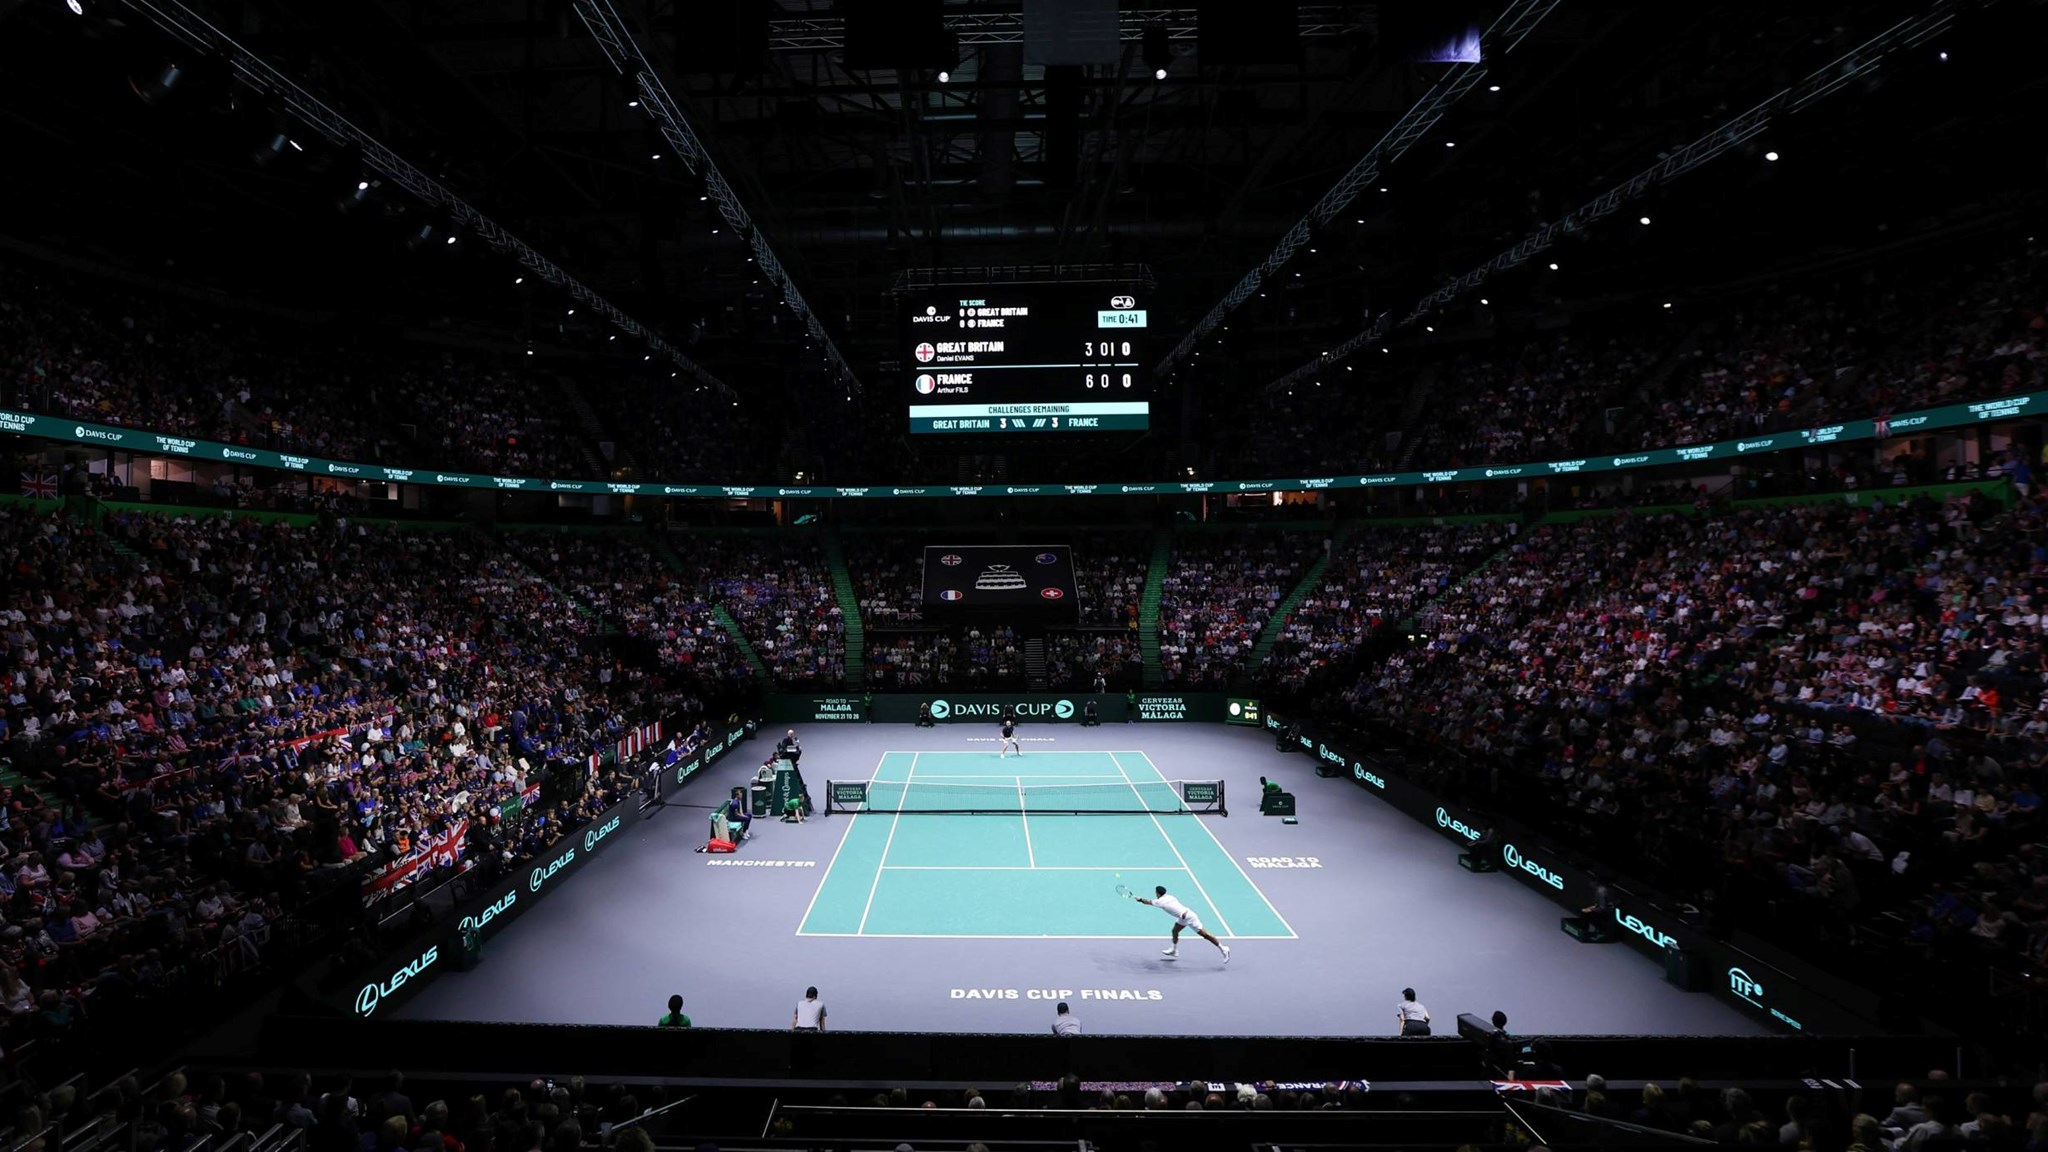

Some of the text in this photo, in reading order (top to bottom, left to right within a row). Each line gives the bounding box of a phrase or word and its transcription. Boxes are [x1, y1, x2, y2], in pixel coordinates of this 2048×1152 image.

[960, 307, 1028, 317] 0 GREAT BRITAIN
[960, 319, 1004, 328] 0 FRANCE
[1118, 314, 1138, 324] 0:41
[937, 341, 1130, 356] GREAT BRITAIN 3 0 0
[937, 374, 1131, 388] FRANCE 6 0 0
[988, 405, 1070, 414] CHALLENGES REMAINING
[1985, 400, 2013, 410] WORLD
[1991, 407, 2019, 417] TENNIS
[0, 413, 35, 424] ORLD CUP
[933, 417, 1098, 429] GREAT BRITAIN 3 3 FRANCE
[1911, 417, 1927, 425] CUP
[0, 421, 25, 430] TENNIS
[86, 430, 106, 439] DAVIS
[167, 438, 185, 446] WORLD
[171, 445, 188, 453] TENNIS
[955, 704, 1050, 715] DAVIS CUP
[1519, 855, 1563, 890] LEXUS
[475, 890, 516, 928] LEXUS
[380, 945, 437, 997] LEXUS
[1731, 974, 1753, 996] ITF
[950, 989, 1163, 1000] DAVIS CUP FINALS
